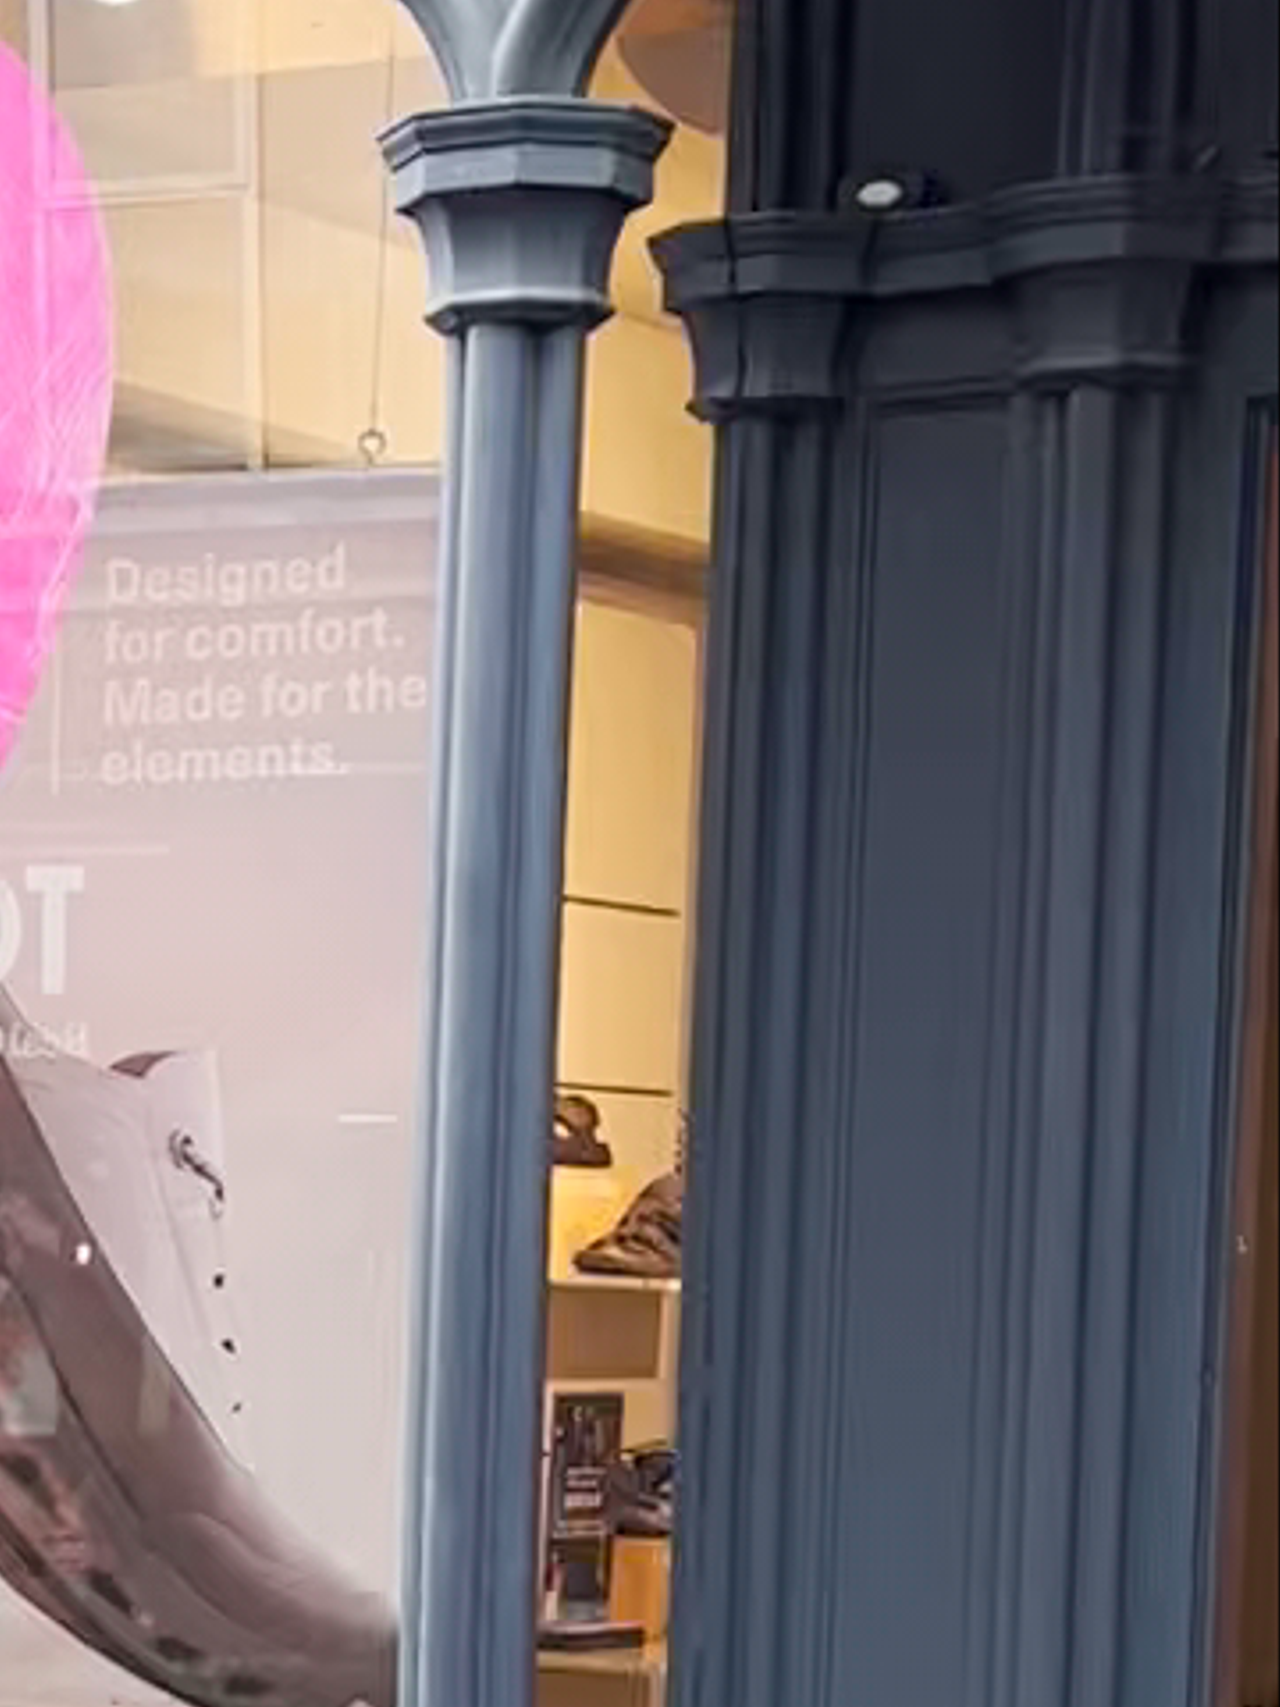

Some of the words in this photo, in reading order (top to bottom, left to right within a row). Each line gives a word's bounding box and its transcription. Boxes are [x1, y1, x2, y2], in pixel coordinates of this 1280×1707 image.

[105, 542, 345, 607] Designed
[104, 620, 176, 664] for
[185, 607, 406, 660] comfort.
[102, 674, 244, 727] Made
[259, 672, 332, 718] for
[344, 665, 427, 714] the
[99, 739, 349, 786] elements.
